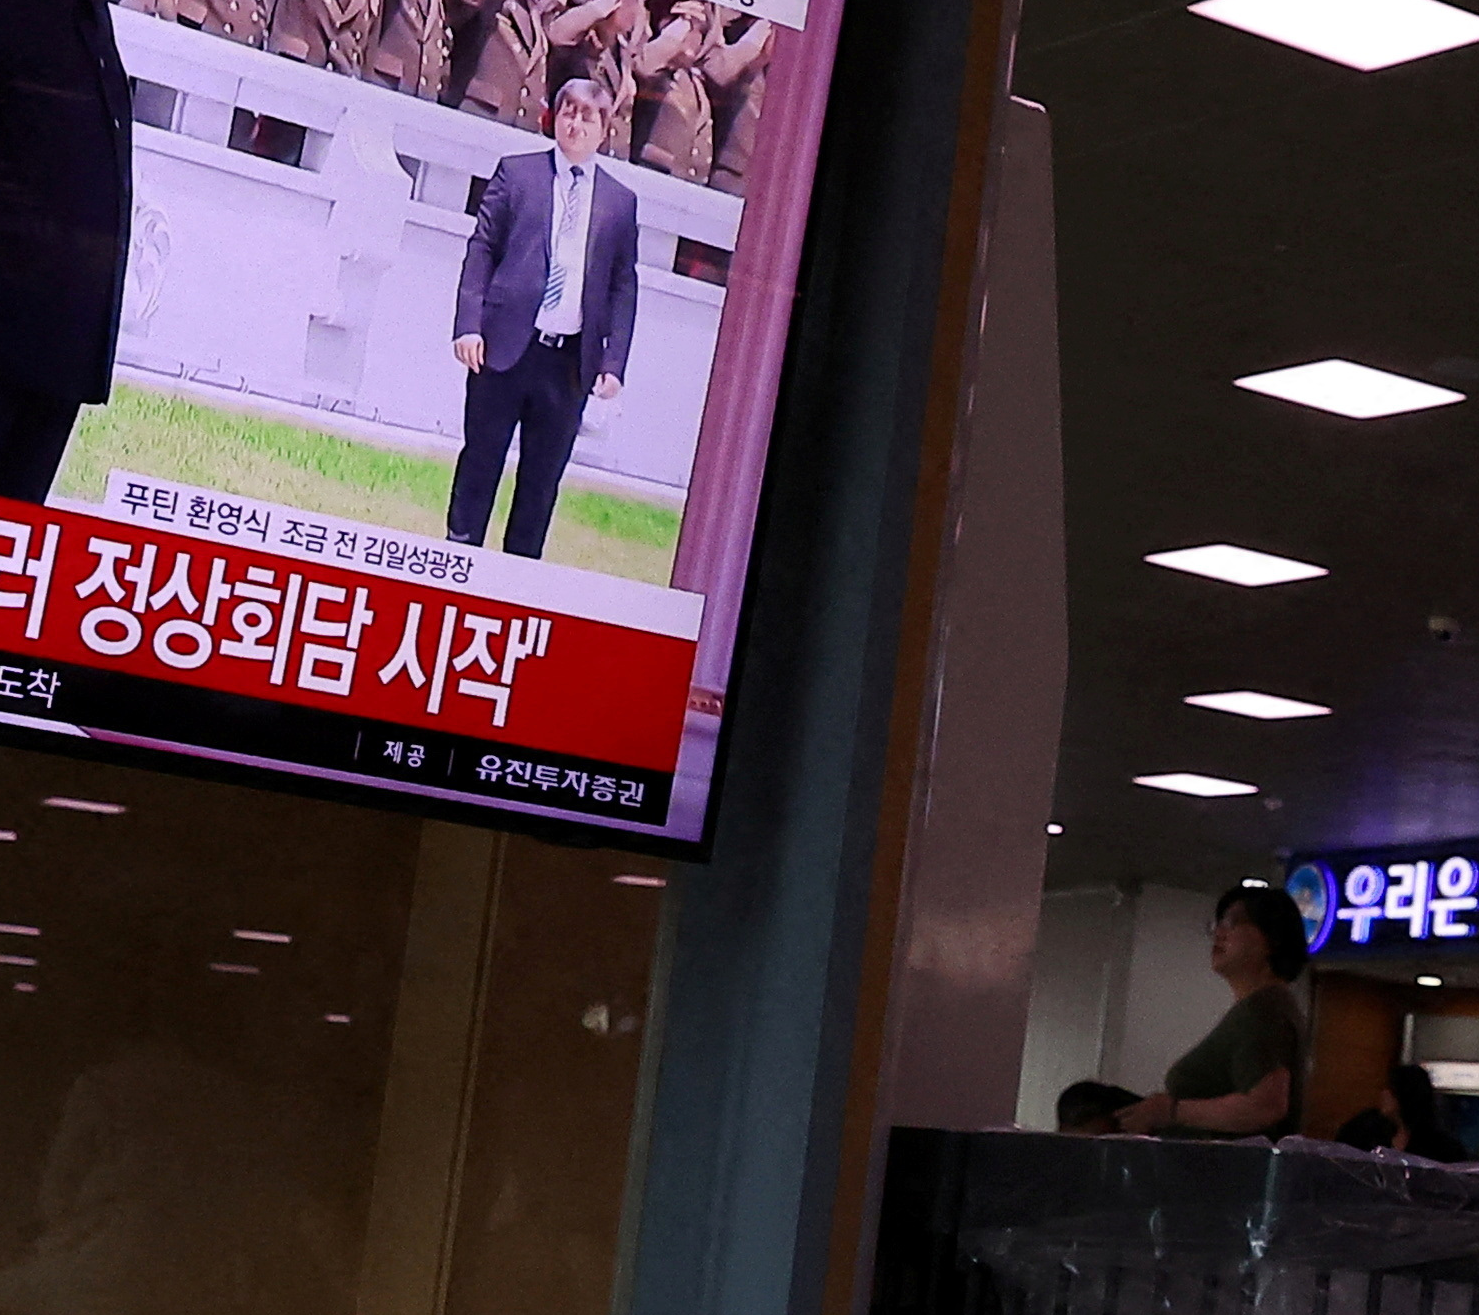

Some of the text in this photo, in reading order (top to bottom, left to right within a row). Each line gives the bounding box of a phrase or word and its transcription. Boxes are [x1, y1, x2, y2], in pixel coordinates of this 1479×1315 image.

[121, 482, 474, 584] 푸틴 환영식 조금 전 김일성광장
[76, 537, 372, 696] 정상회담
[378, 601, 552, 727] 시작"
[383, 739, 426, 768] 제공
[475, 754, 646, 808] 유진투자증권
